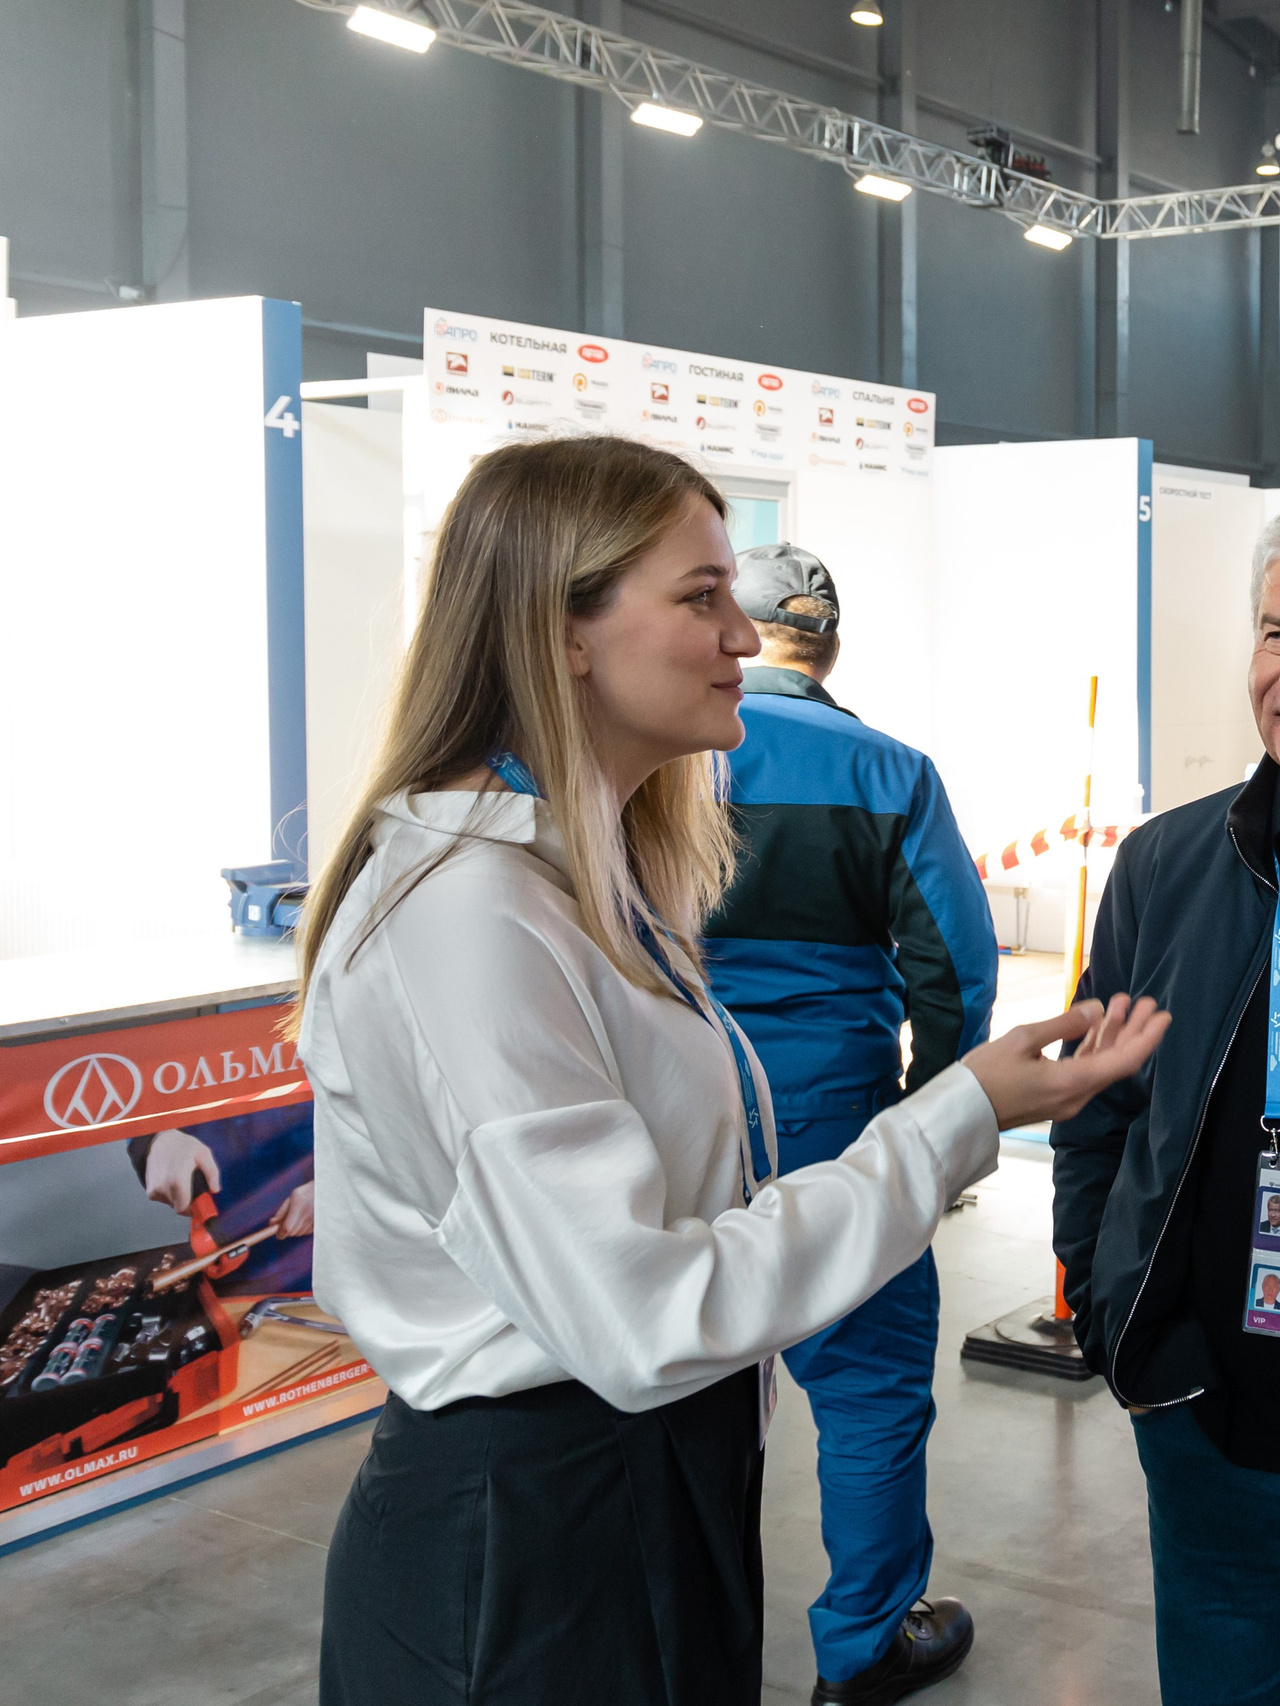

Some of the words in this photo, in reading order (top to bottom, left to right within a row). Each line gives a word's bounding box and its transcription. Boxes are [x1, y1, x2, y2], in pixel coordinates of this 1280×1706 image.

[489, 332, 567, 354] КОТЕЛЬНАЯ
[689, 364, 743, 382] ГОСТИНАЯ
[852, 391, 895, 406] СПАЛЬНЯ
[264, 394, 301, 438] 4
[1159, 486, 1198, 498] СКОРОСТНОЙ
[1139, 495, 1152, 522] 5
[1253, 1316, 1266, 1324] VIP
[19, 1446, 138, 1497] WWW.OLMAX.RU
